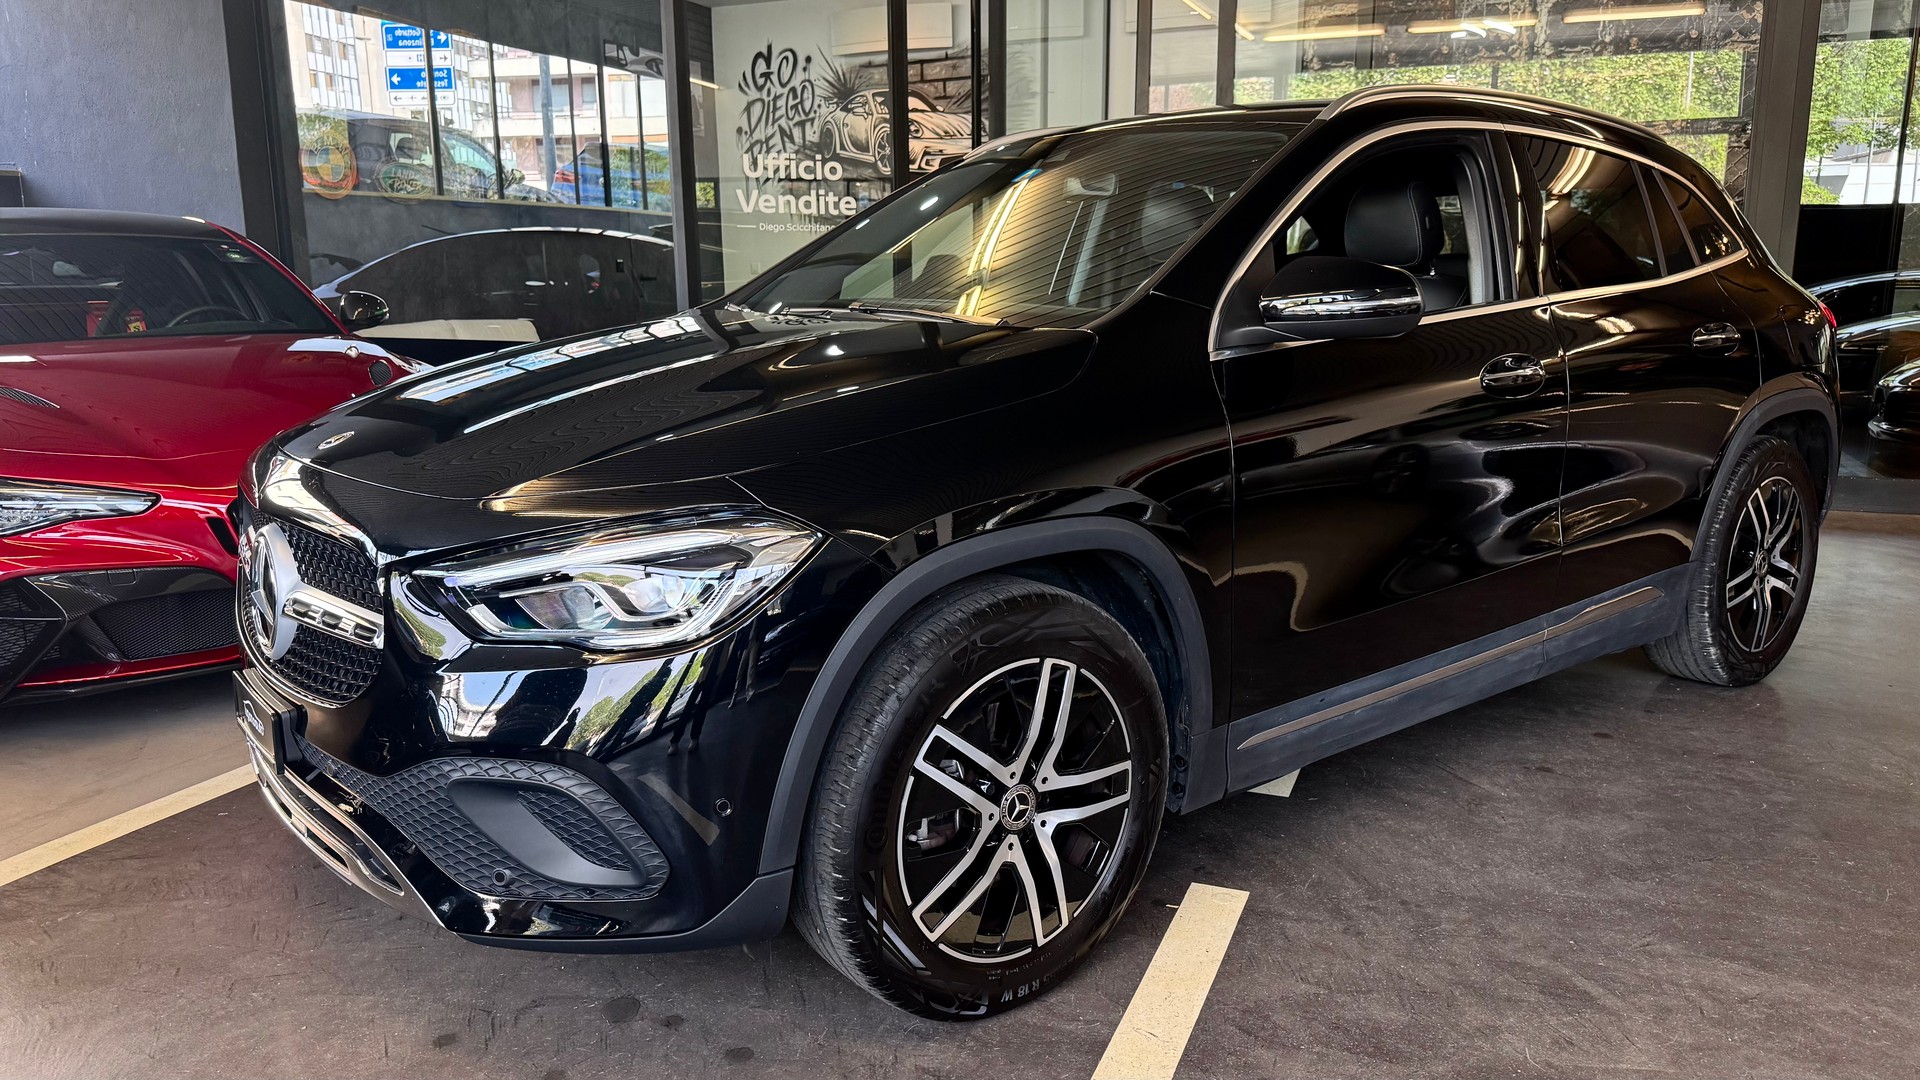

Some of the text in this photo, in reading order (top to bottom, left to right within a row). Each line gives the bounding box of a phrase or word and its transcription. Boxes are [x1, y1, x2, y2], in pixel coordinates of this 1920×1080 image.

[751, 40, 798, 92] GO
[742, 153, 843, 181] Ufficio
[735, 188, 857, 216] Vendite
[759, 222, 785, 233] Diego
[1000, 988, 1013, 1002] W
